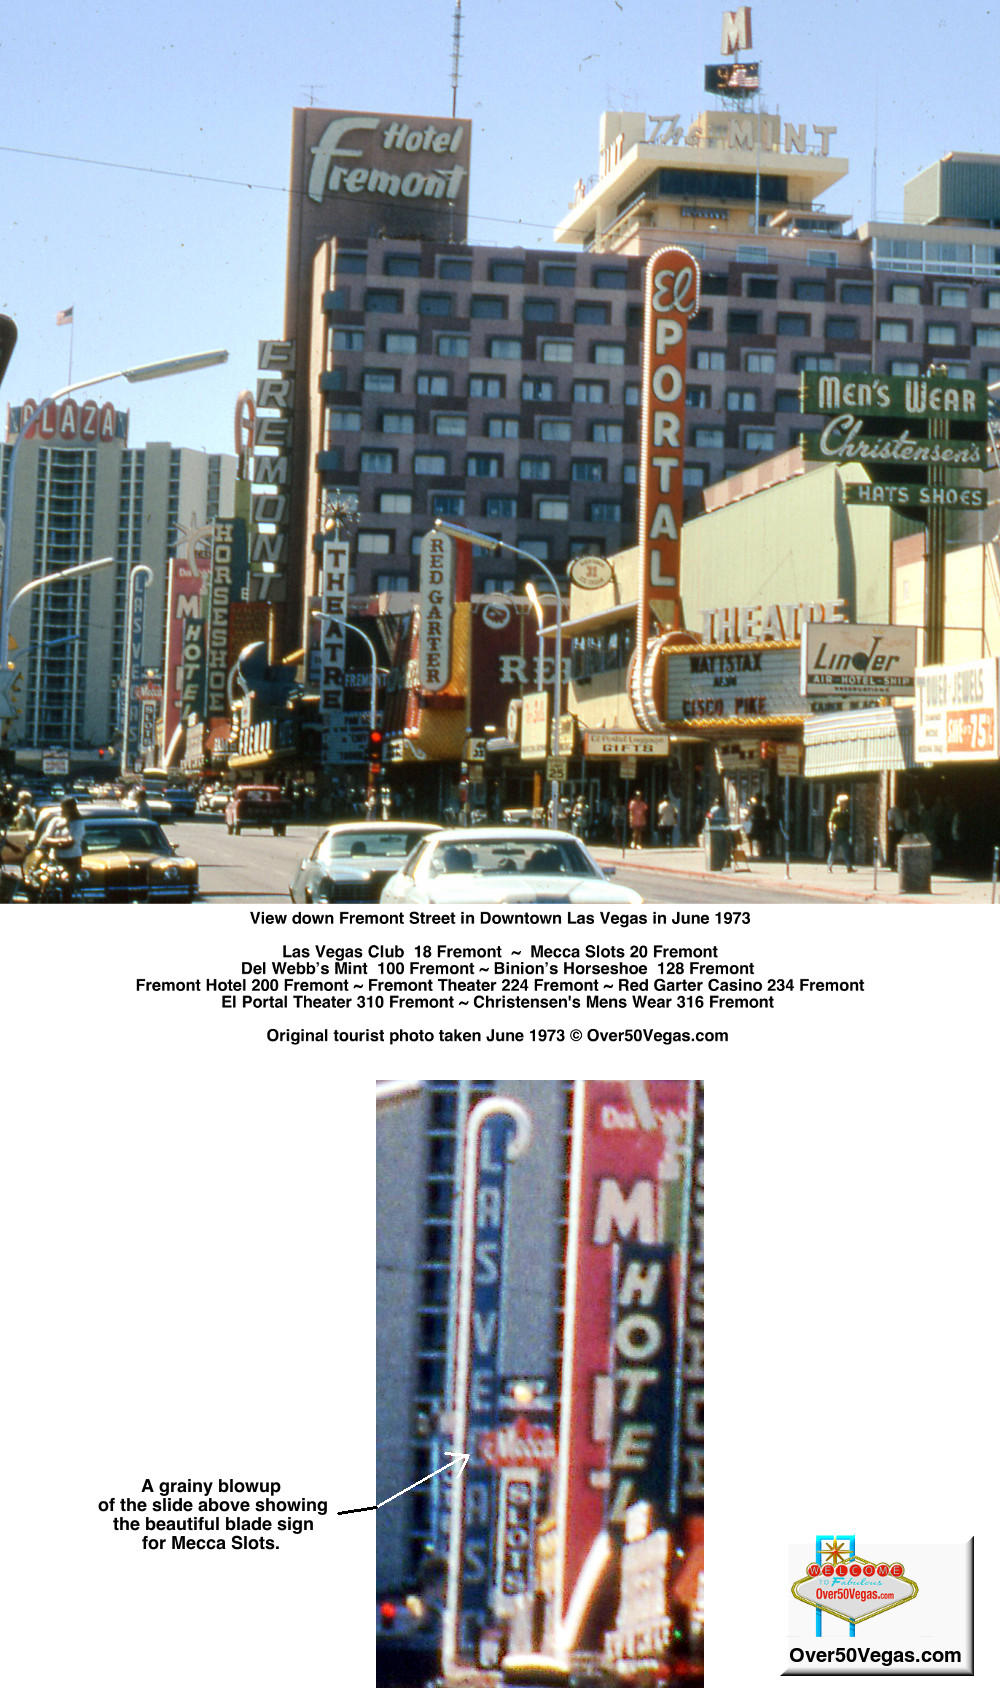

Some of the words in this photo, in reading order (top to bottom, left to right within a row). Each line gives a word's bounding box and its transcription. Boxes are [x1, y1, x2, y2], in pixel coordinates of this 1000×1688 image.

[720, 6, 752, 56] M
[383, 122, 464, 154] Hotel
[648, 114, 703, 147] The
[727, 119, 838, 157] MINT
[308, 117, 468, 203] Fremont
[652, 267, 694, 313] El
[905, 380, 976, 413] WEAR
[23, 404, 113, 437] PLAZA
[820, 413, 981, 463] Christensen's
[252, 340, 292, 600] FREMONT
[650, 318, 684, 587] PORTAL
[858, 485, 909, 502] HATS
[919, 488, 982, 505] SHOES
[429, 538, 444, 585] RED
[208, 523, 234, 712] HORSESHOE
[323, 548, 346, 709] THEATRE
[426, 589, 444, 684] GARTER
[690, 652, 763, 674] WATTSTAX
[814, 635, 900, 673] Linder
[813, 675, 833, 684] AIR
[841, 676, 875, 685] HOTEL
[884, 677, 910, 686] SHIP
[682, 698, 724, 717] CISCO
[735, 696, 767, 715] PIKE
[602, 744, 654, 753] GIFTS
[549, 768, 564, 778] 25
[475, 1128, 503, 1284] LAS
